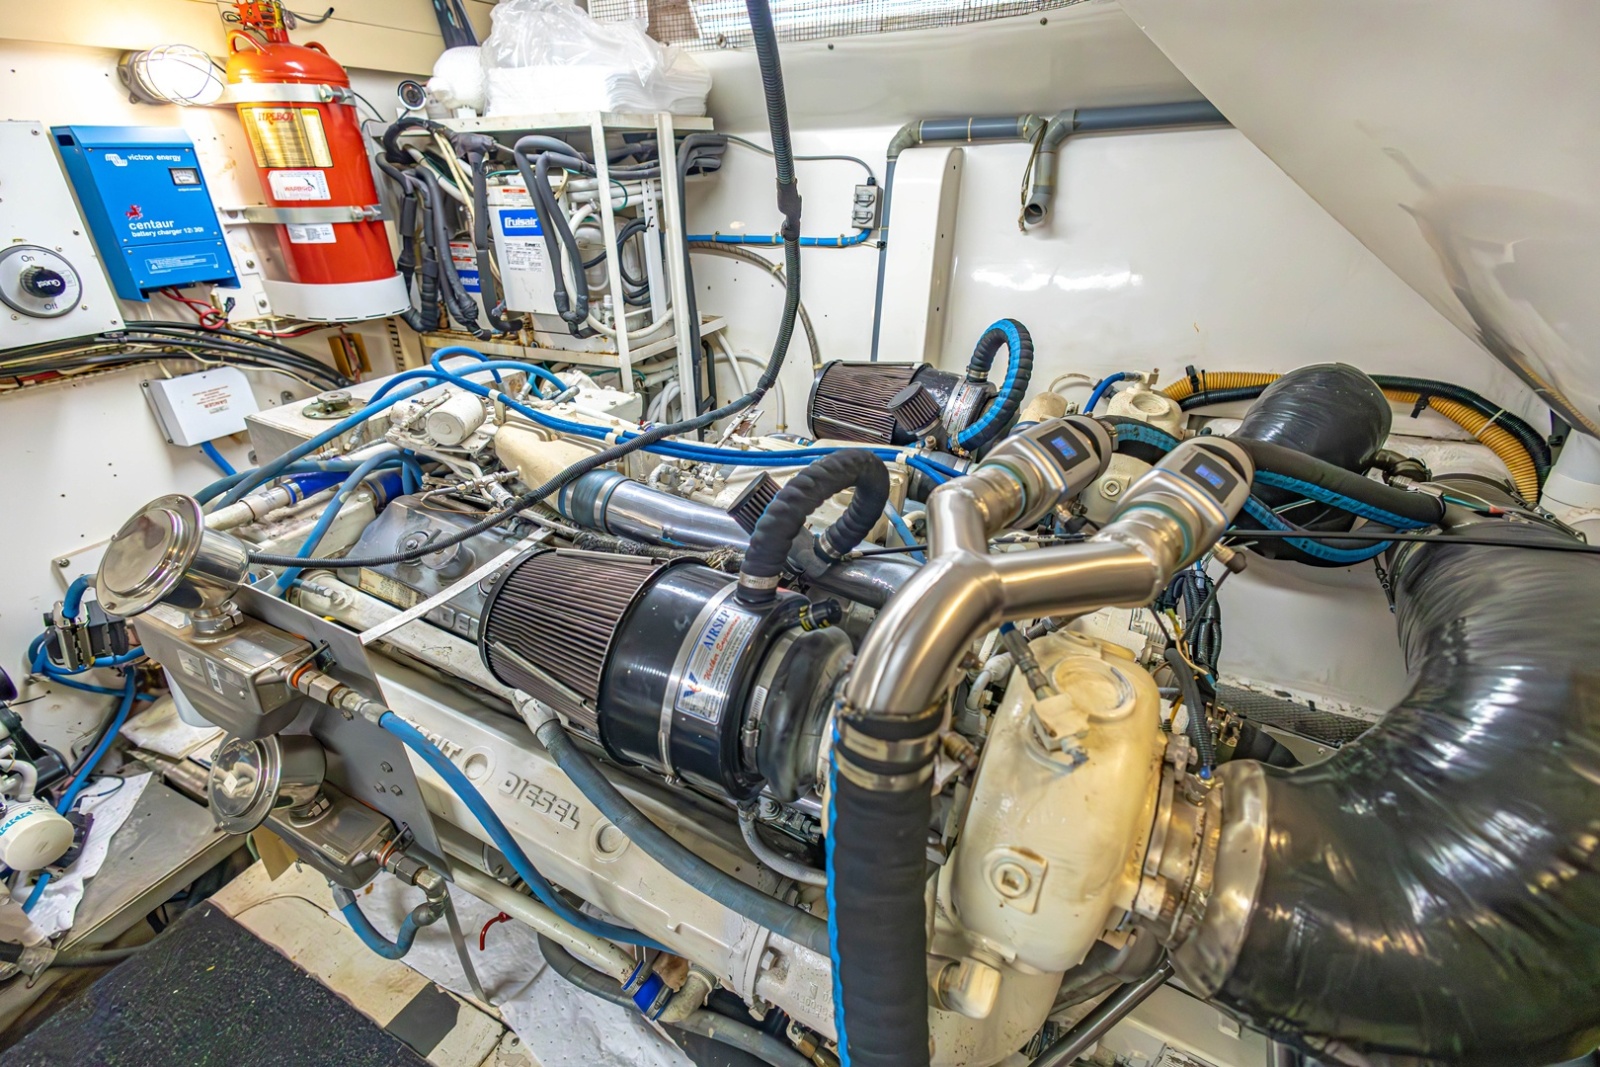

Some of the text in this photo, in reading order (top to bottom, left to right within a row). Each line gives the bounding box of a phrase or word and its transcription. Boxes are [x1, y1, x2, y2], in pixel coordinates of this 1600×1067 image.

[156, 154, 182, 162] energy
[128, 220, 174, 230] centaur
[504, 217, 539, 228] Cruisair
[131, 230, 156, 238] battery
[44, 303, 58, 311] Off
[703, 610, 730, 651] AIRSEP
[703, 653, 719, 681] Walker
[716, 615, 742, 652] Engineering
[498, 771, 581, 830] DIESEL
